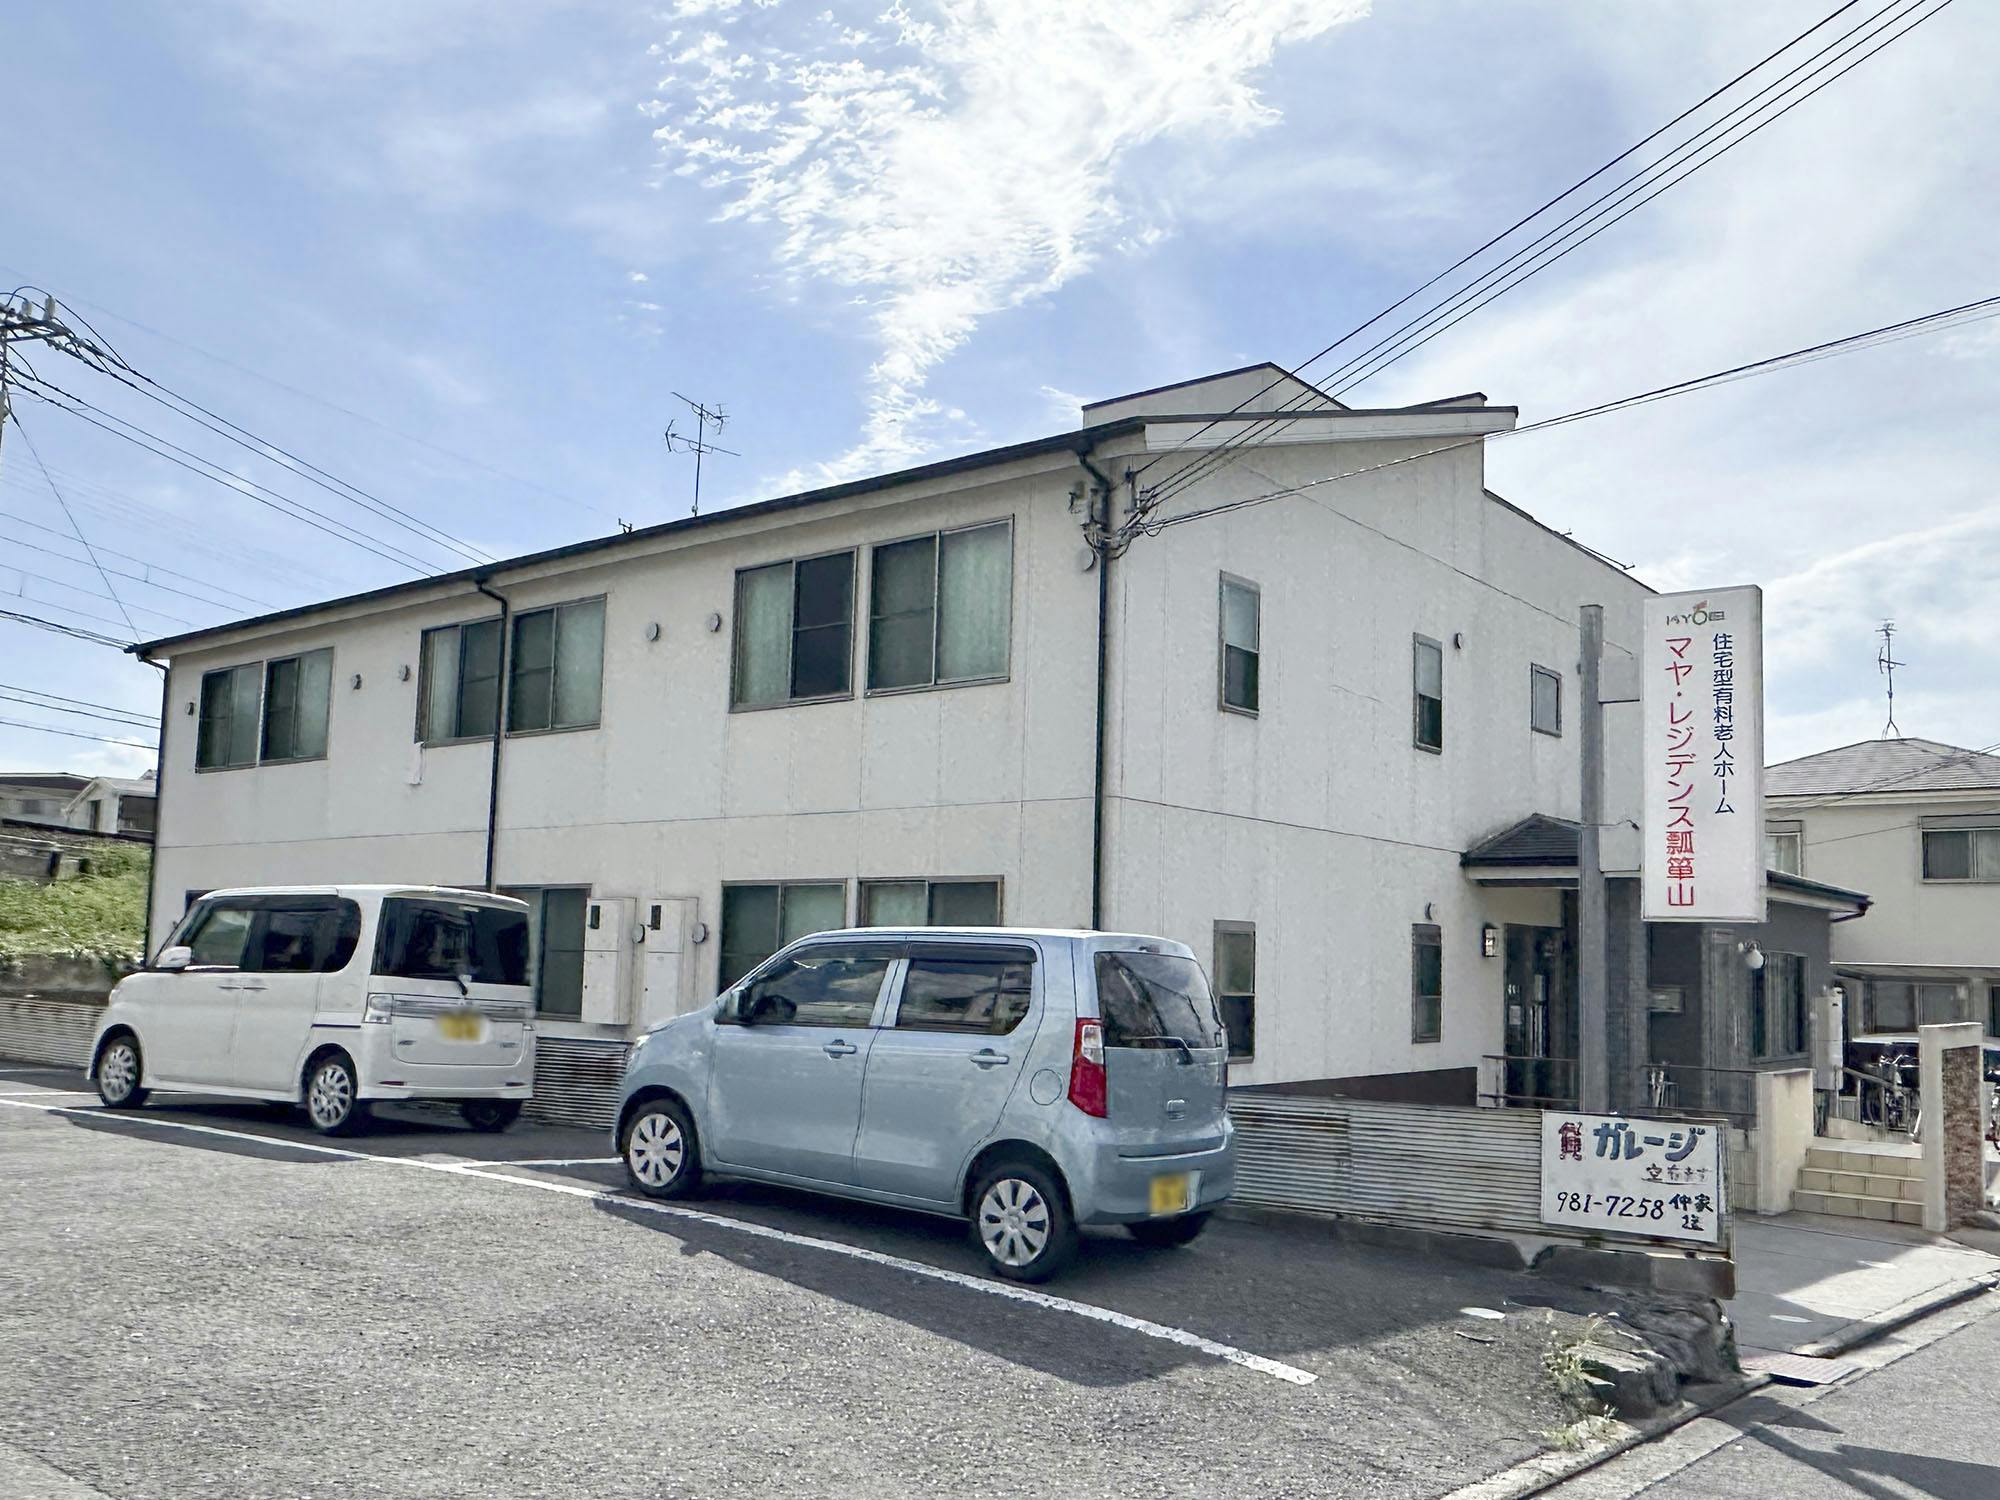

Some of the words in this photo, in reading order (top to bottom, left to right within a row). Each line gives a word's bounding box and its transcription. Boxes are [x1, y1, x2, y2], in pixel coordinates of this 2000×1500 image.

[1713, 633, 1734, 815] 住宅型有料老人ホーム
[1557, 1191, 1664, 1220] 981-7258
